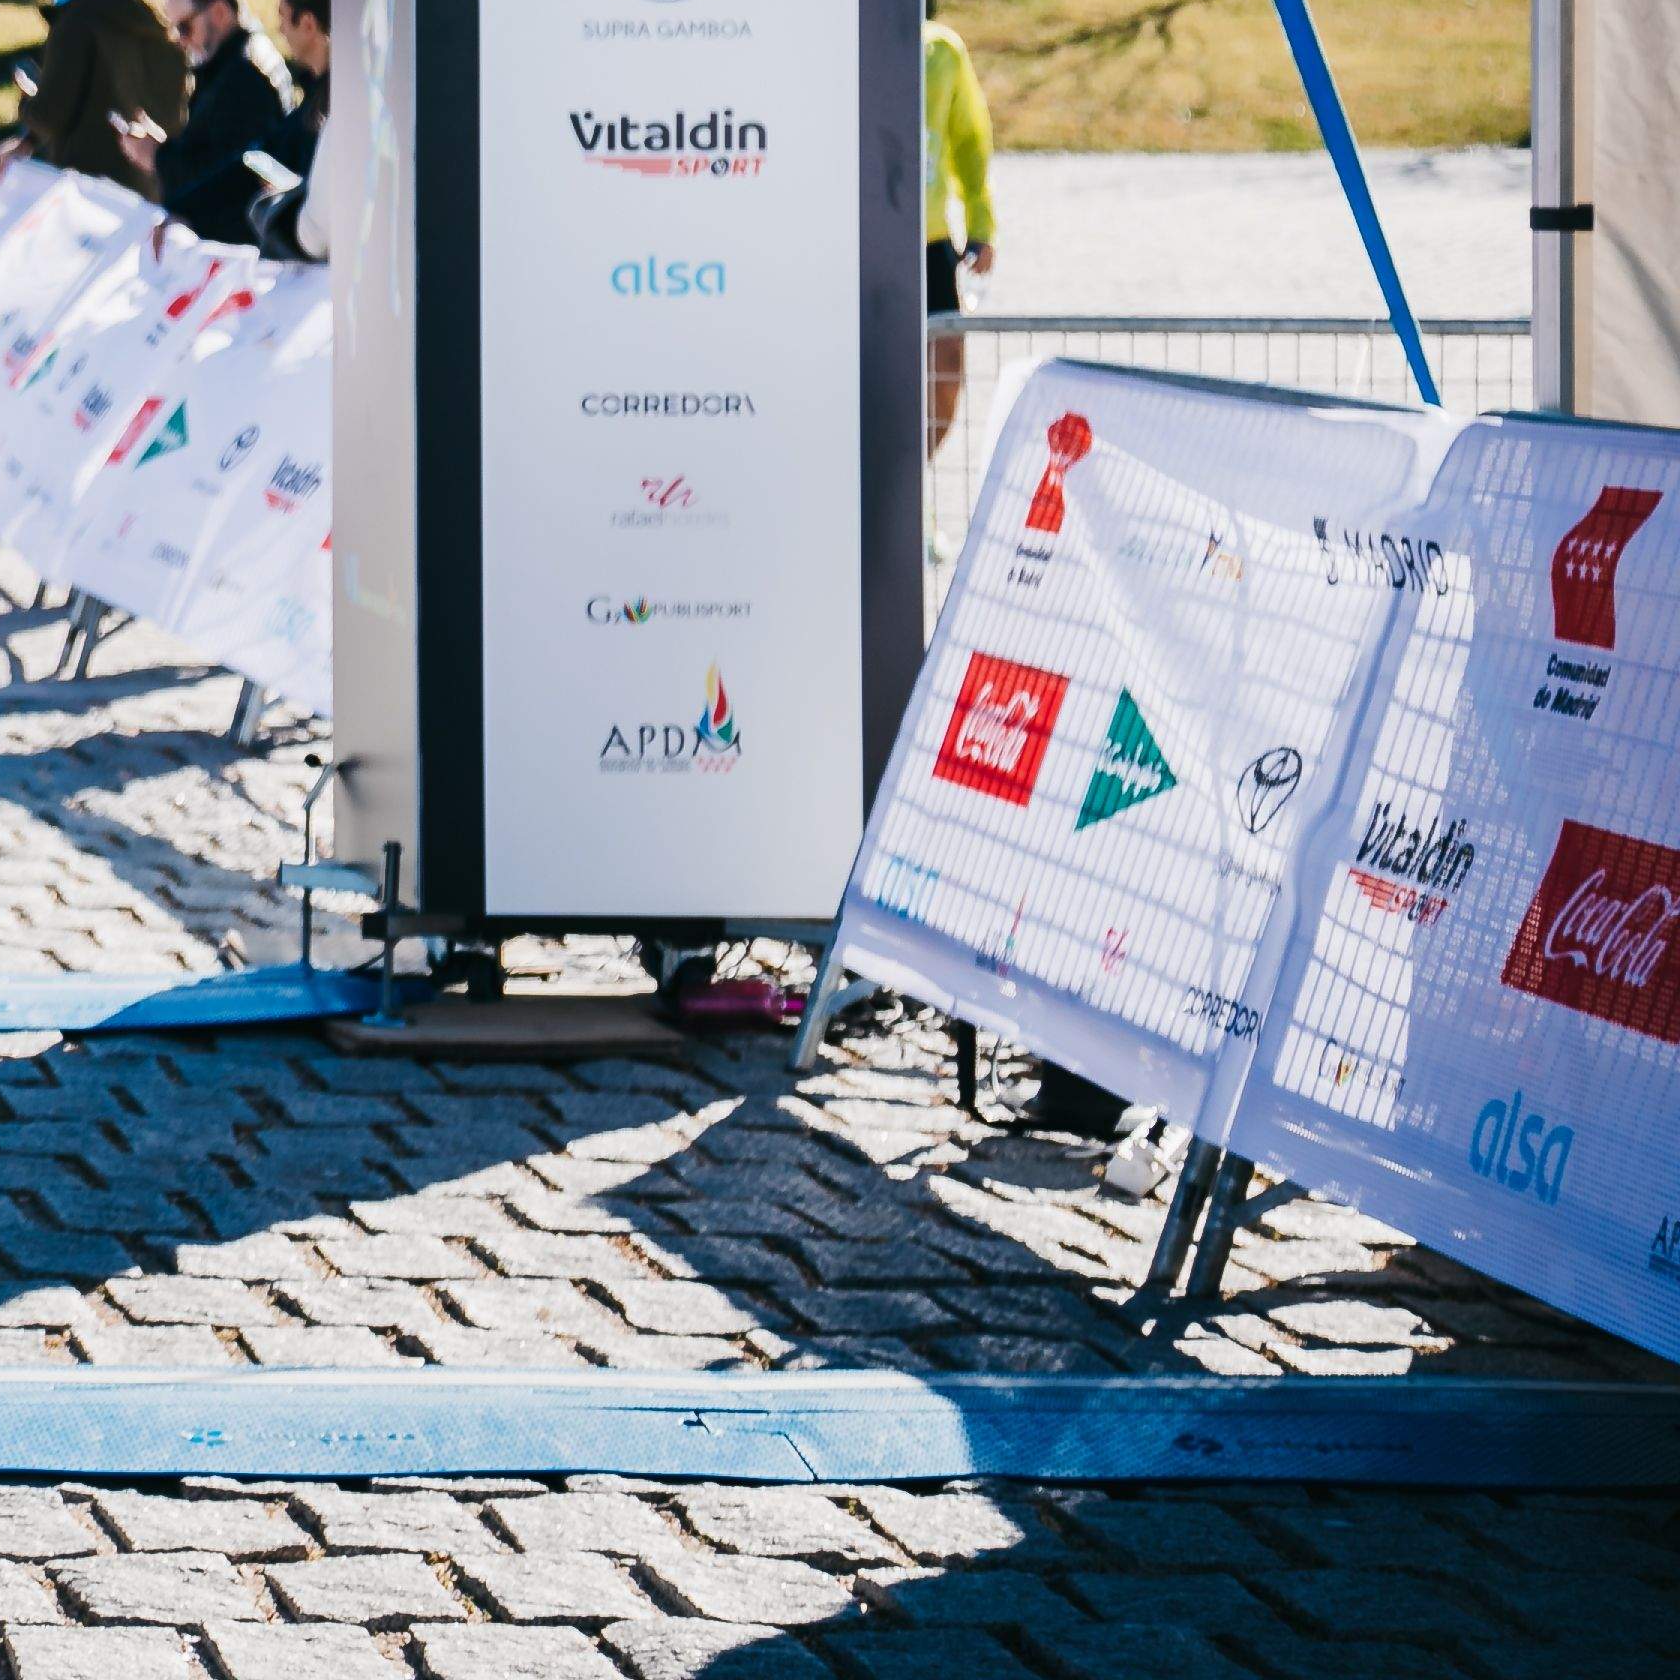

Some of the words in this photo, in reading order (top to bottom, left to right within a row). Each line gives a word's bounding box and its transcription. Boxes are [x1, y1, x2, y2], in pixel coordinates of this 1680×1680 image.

[582, 20, 650, 39] SUPRA
[657, 20, 753, 39] GAMBOA
[569, 108, 768, 152] Vitaldin
[674, 157, 765, 177] SPORT
[610, 256, 726, 295] alsa
[1343, 528, 1449, 596] MADRID
[1546, 652, 1612, 688] Comunidad
[1550, 686, 1601, 721] Madrid
[1356, 802, 1476, 895] Vitaldin
[1394, 886, 1450, 927] SPORT
[1467, 1087, 1574, 1206] alsa
